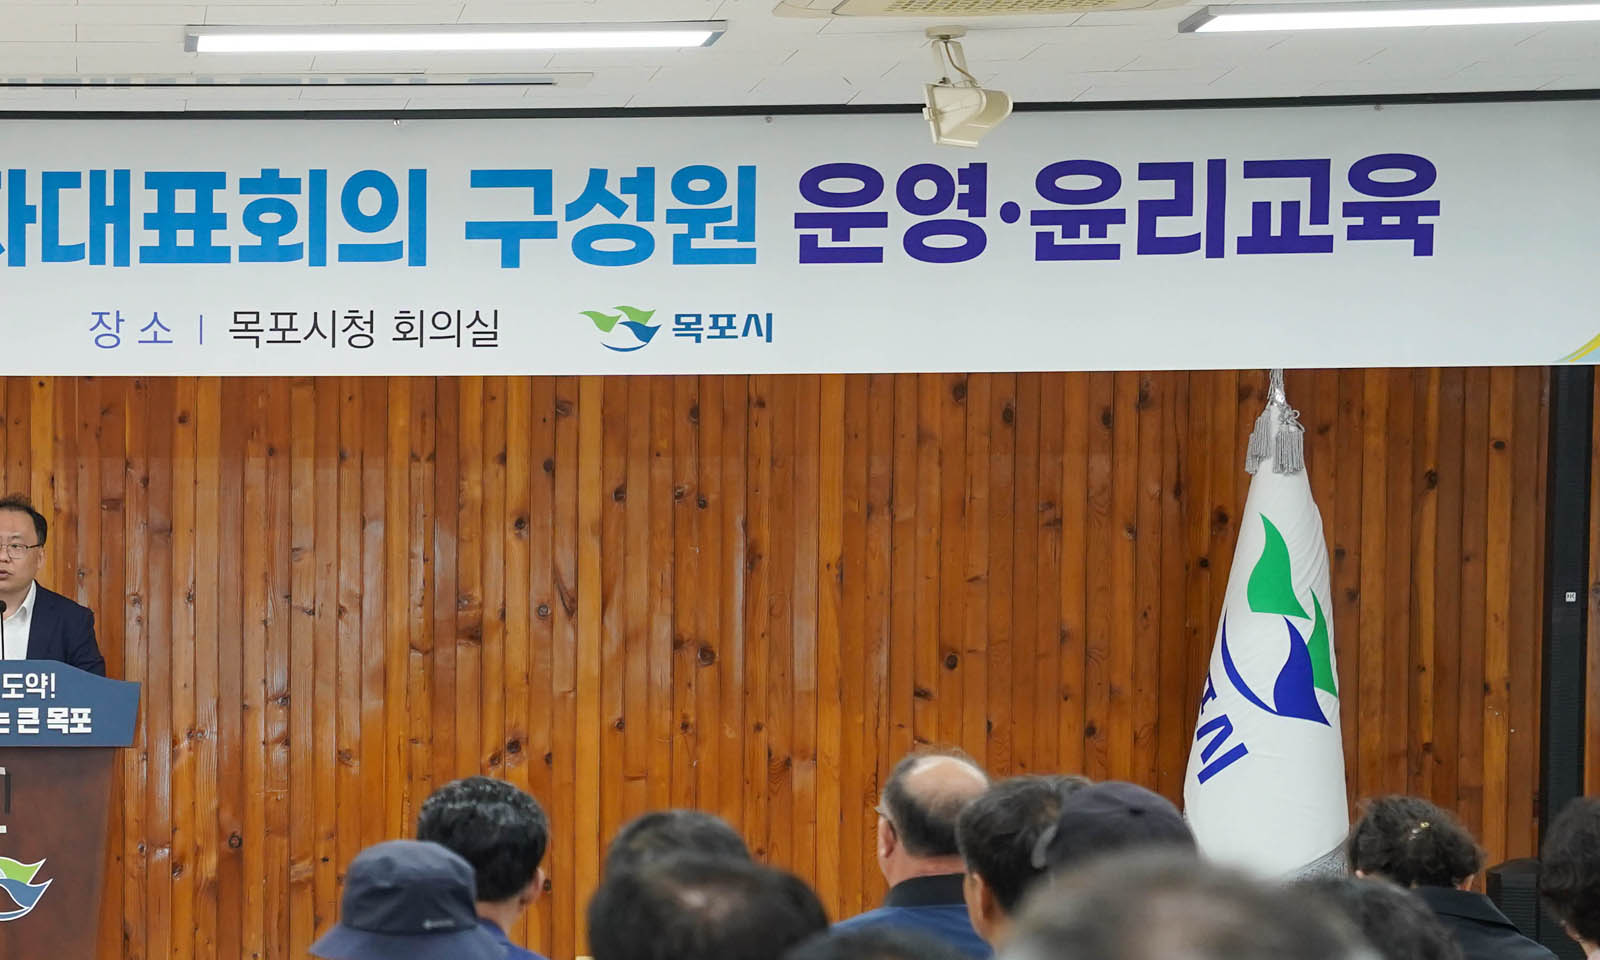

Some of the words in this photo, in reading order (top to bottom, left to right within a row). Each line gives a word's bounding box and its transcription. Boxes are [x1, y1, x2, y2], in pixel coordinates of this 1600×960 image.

[464, 164, 758, 270] 구성원
[793, 152, 1441, 265] 운영·윤리교육
[228, 309, 375, 350] 목포시청
[391, 308, 499, 349] 회의실
[671, 312, 774, 344] 목포시
[2, 672, 57, 700] 도약!
[17, 707, 41, 734] 큰
[46, 707, 93, 735] 목포
